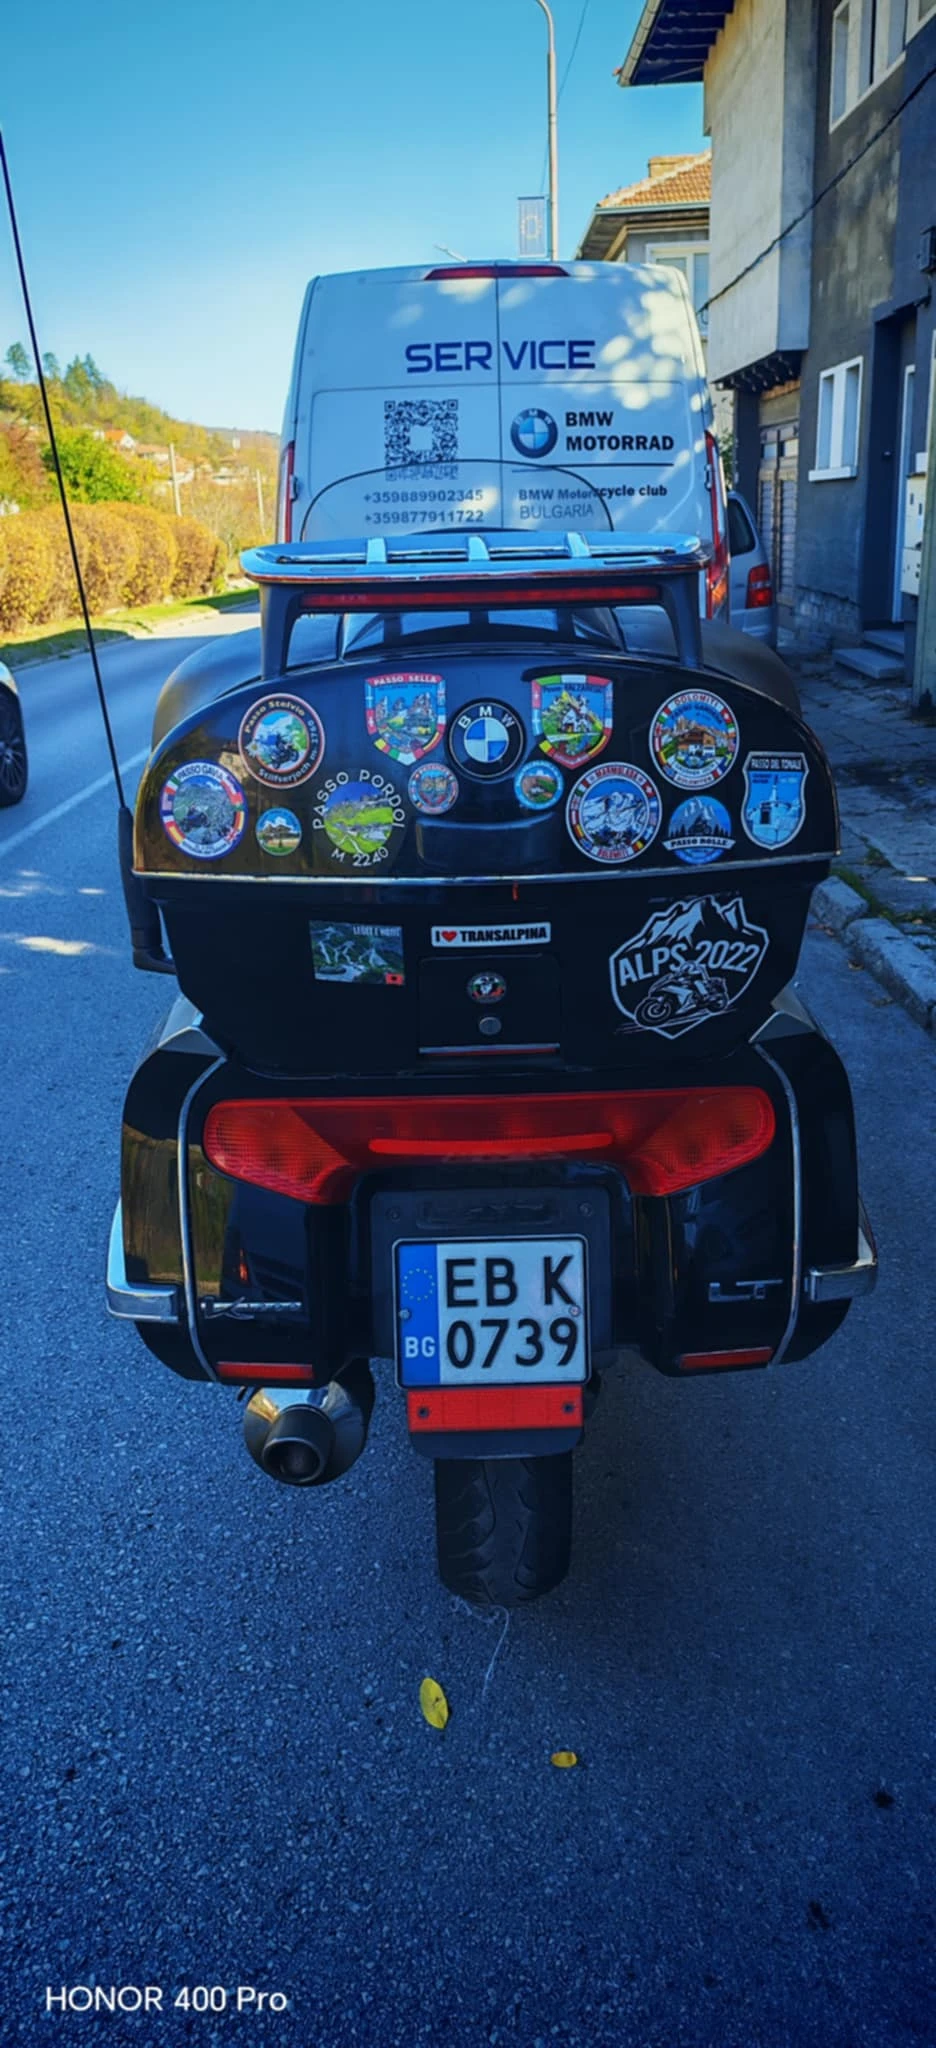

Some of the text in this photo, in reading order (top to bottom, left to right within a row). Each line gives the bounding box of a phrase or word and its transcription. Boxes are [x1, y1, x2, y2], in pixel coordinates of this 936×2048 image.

[565, 412, 614, 427] BMW
[565, 435, 675, 451] MOTORRAD
[518, 488, 554, 501] BMW
[639, 484, 668, 497] club
[364, 510, 484, 525] +359877911722
[519, 503, 594, 519] BULGARIA
[374, 675, 437, 686] PASSO SELLA
[244, 701, 305, 734] Passo Stelvio
[457, 705, 516, 728] BMW
[312, 769, 406, 830] PASSO PORDOI
[331, 846, 389, 868] M 2240
[435, 927, 548, 942] I TRANSALPINA
[619, 940, 760, 987] ALPS 2022
[445, 1255, 575, 1307] EB K
[404, 1336, 436, 1359] BG
[446, 1318, 579, 1369] 0739
